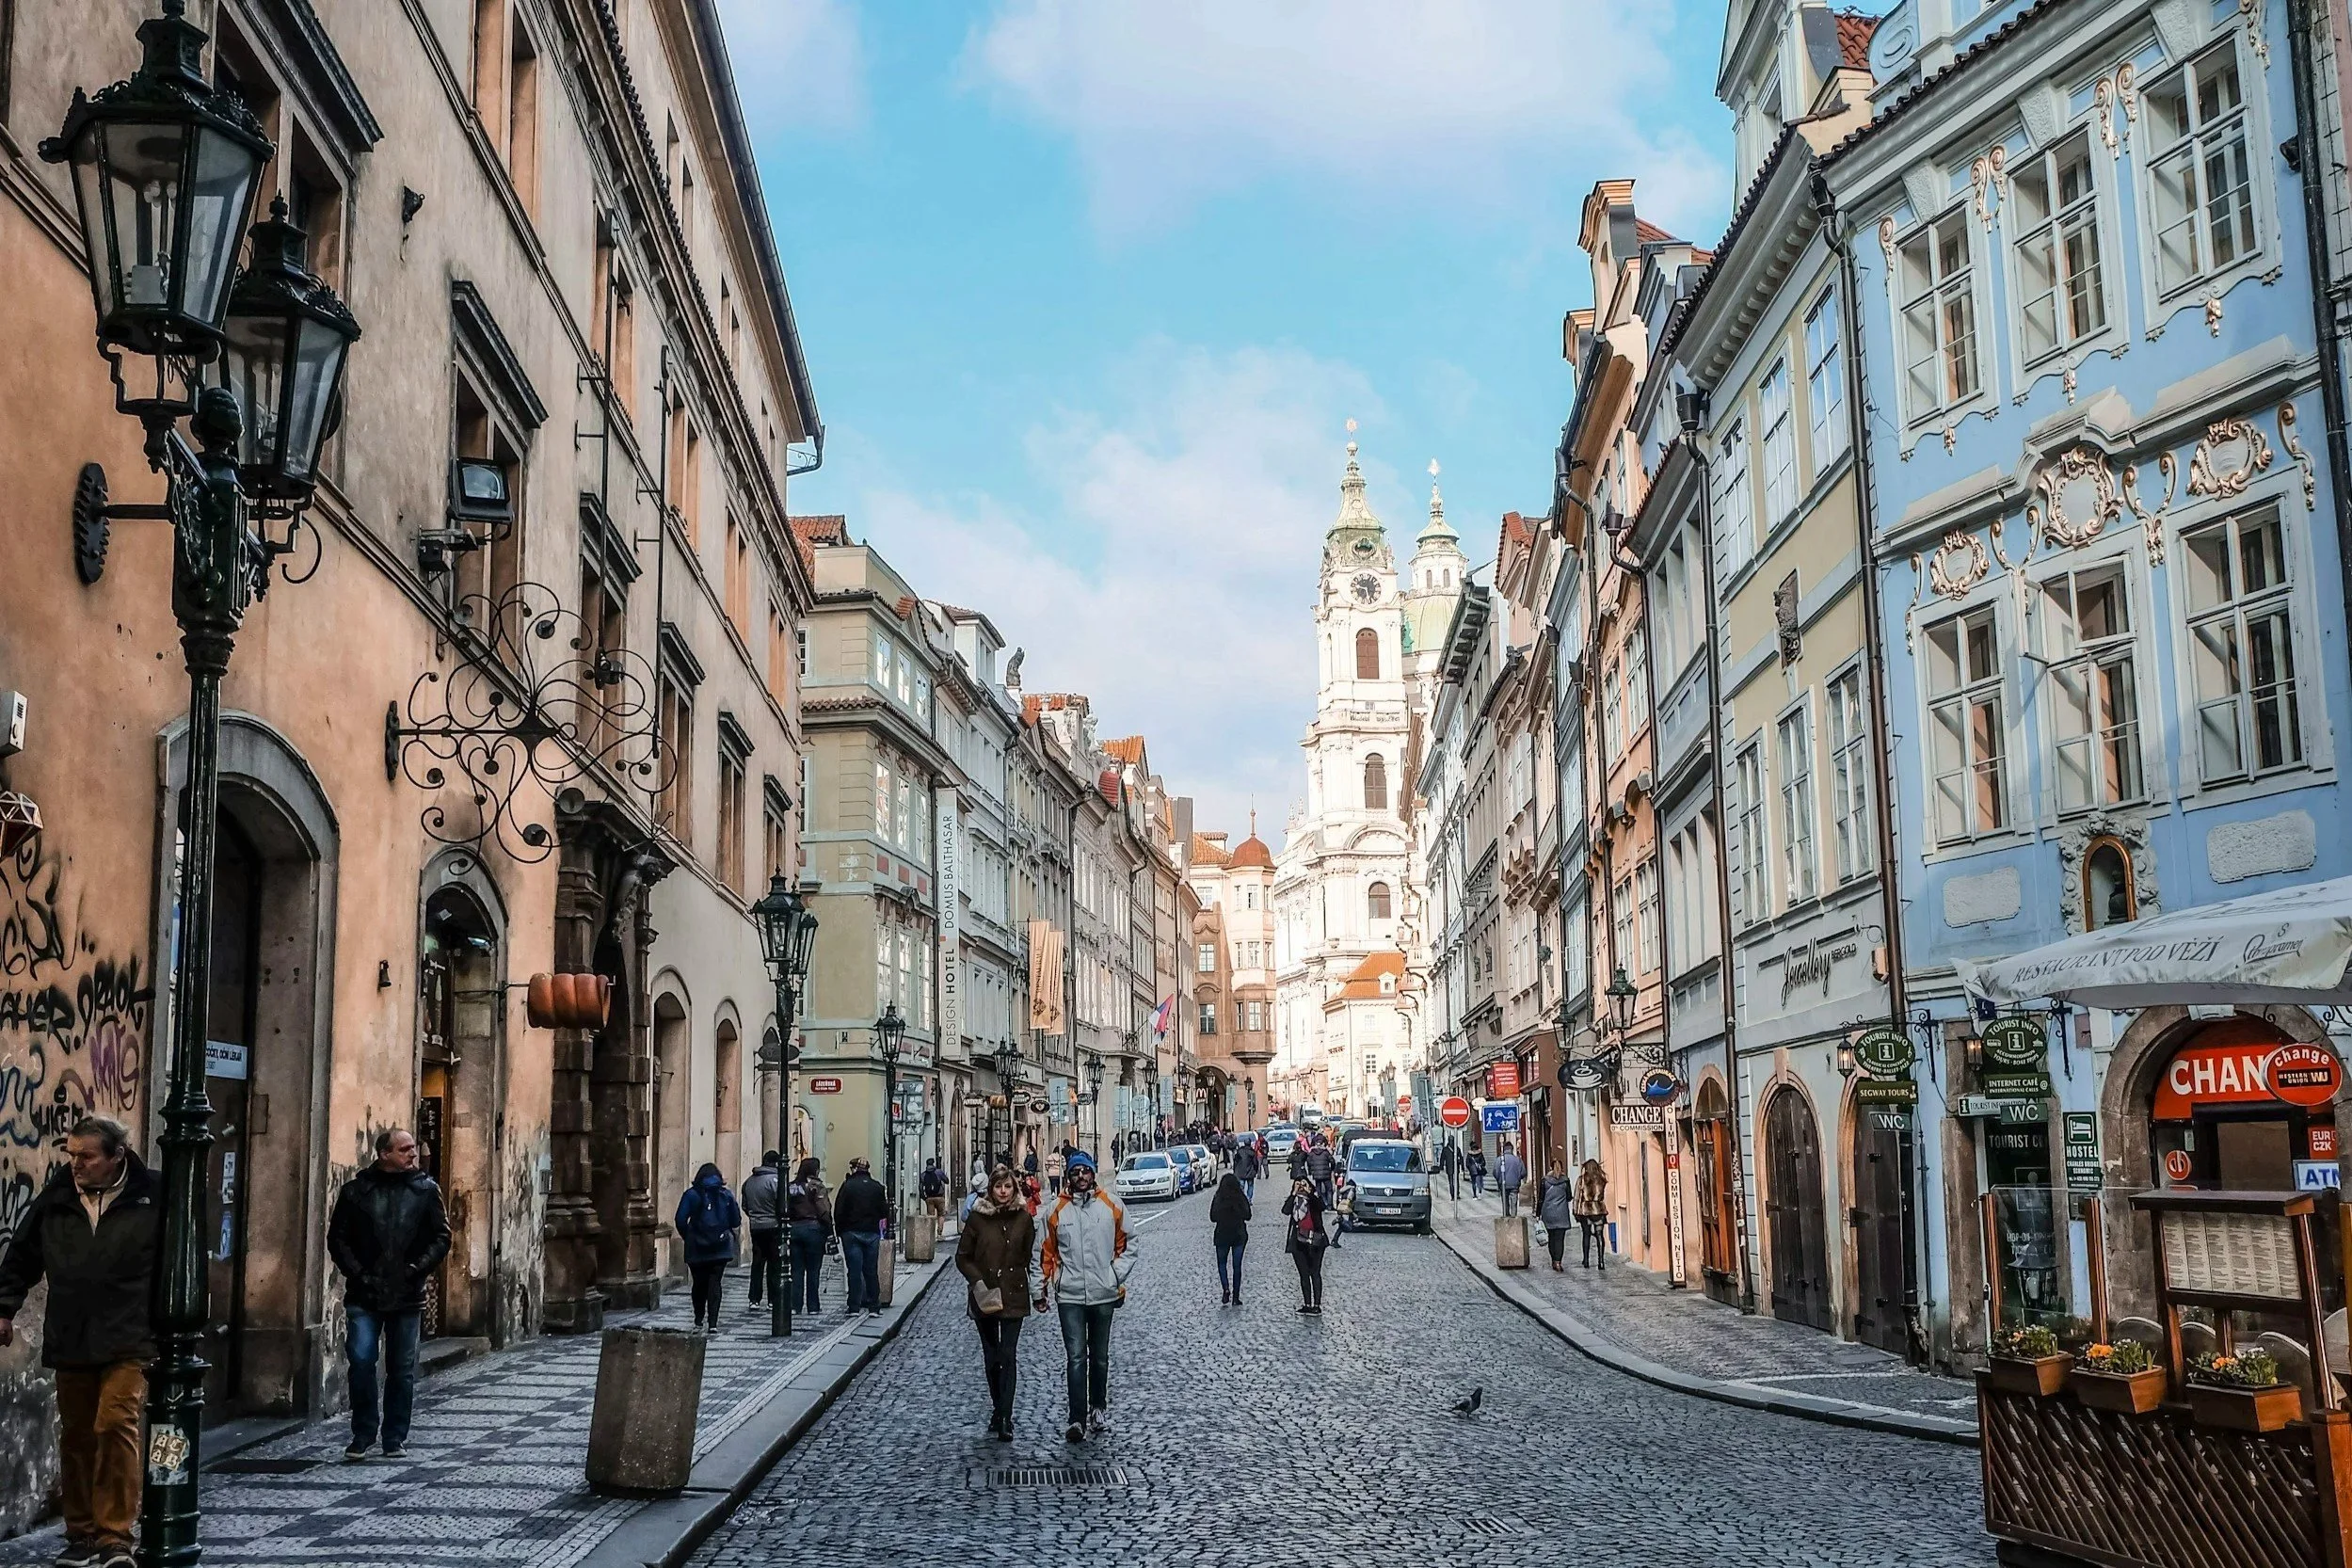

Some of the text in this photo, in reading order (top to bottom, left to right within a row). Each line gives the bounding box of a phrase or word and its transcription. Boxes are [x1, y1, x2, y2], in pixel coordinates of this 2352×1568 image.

[943, 815, 956, 1046] DESIGN HOTEL DOMUS BALTHASAR
[2122, 944, 2168, 963] POD
[1988, 1019, 2040, 1035] TOURIST INFO
[1860, 1032, 1908, 1047] TOURIST INFO
[1993, 1053, 2009, 1064] TOURS
[2274, 1048, 2329, 1066] change
[1989, 1080, 2022, 1088] INTERNET
[2022, 1078, 2039, 1086] CAFÉ
[1860, 1089, 1887, 1097] SEGWAY
[1611, 1106, 1661, 1124] CHANGE
[2009, 1105, 2039, 1122] WC
[1878, 1114, 1905, 1129] WC
[1989, 1134, 2029, 1148] TOURIST
[2312, 1141, 2332, 1151] CZK
[2066, 1145, 2099, 1158] HOSTEL
[1671, 1171, 1681, 1240] COMMISSION
[1674, 1245, 1683, 1280] NETTO
